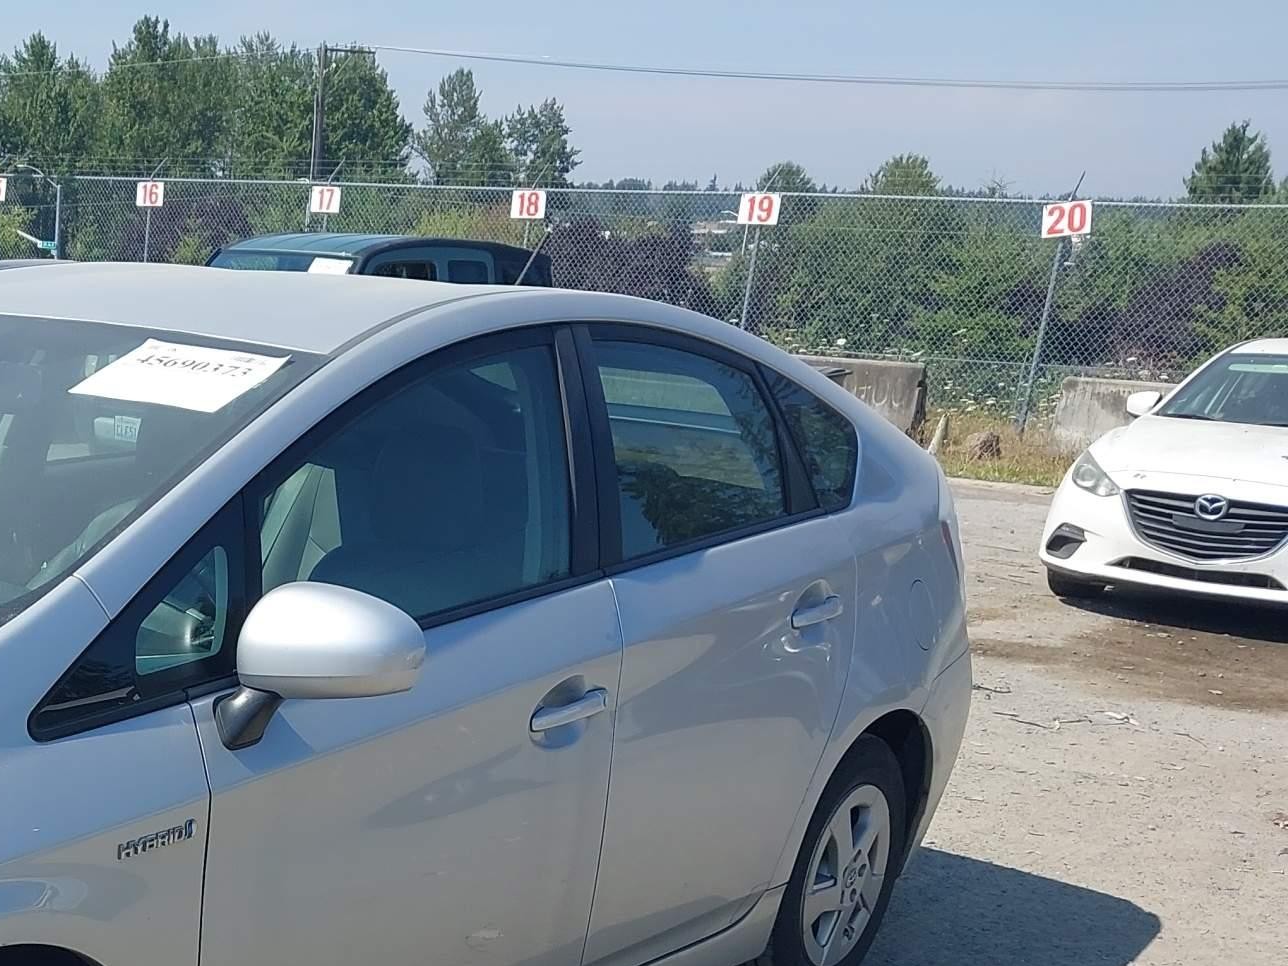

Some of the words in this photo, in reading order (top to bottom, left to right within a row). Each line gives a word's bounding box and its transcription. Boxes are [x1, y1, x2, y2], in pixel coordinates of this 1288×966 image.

[142, 183, 158, 205] 16
[319, 188, 334, 211] 17
[518, 192, 539, 216] 18
[748, 195, 773, 222] 19
[1047, 203, 1086, 236] 20
[136, 354, 253, 377] 45690373
[117, 825, 184, 860] HYBRID
